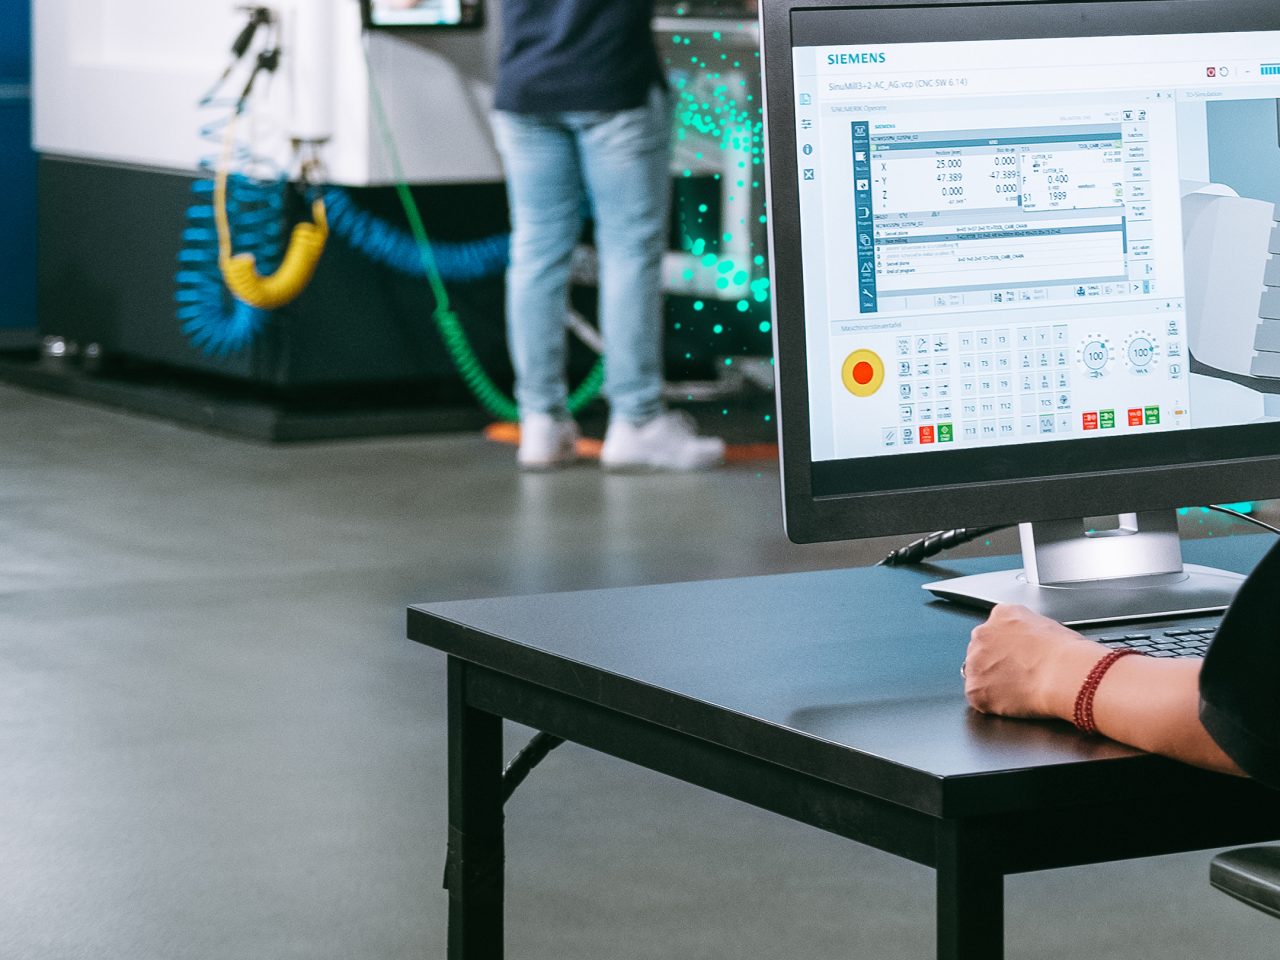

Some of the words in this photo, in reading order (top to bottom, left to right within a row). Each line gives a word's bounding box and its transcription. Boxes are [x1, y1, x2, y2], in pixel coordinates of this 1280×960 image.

[827, 52, 886, 65] SIEMENS
[915, 77, 934, 89] (CNC
[935, 77, 948, 87] SW
[948, 77, 968, 88] 6.14)
[936, 159, 962, 169] 25.000
[994, 156, 1016, 166] 0.000
[881, 163, 887, 171] X
[881, 176, 887, 185] Y
[937, 172, 962, 182] 47.389
[1022, 176, 1027, 184] F
[1047, 174, 1069, 184] 0.400
[941, 186, 964, 196] 0.000
[995, 184, 1017, 193] 0.000
[882, 190, 887, 200] Z
[1023, 193, 1032, 202] S1
[1049, 191, 1067, 201] 1989
[1089, 351, 1104, 361] 100
[1134, 348, 1148, 358] 100
